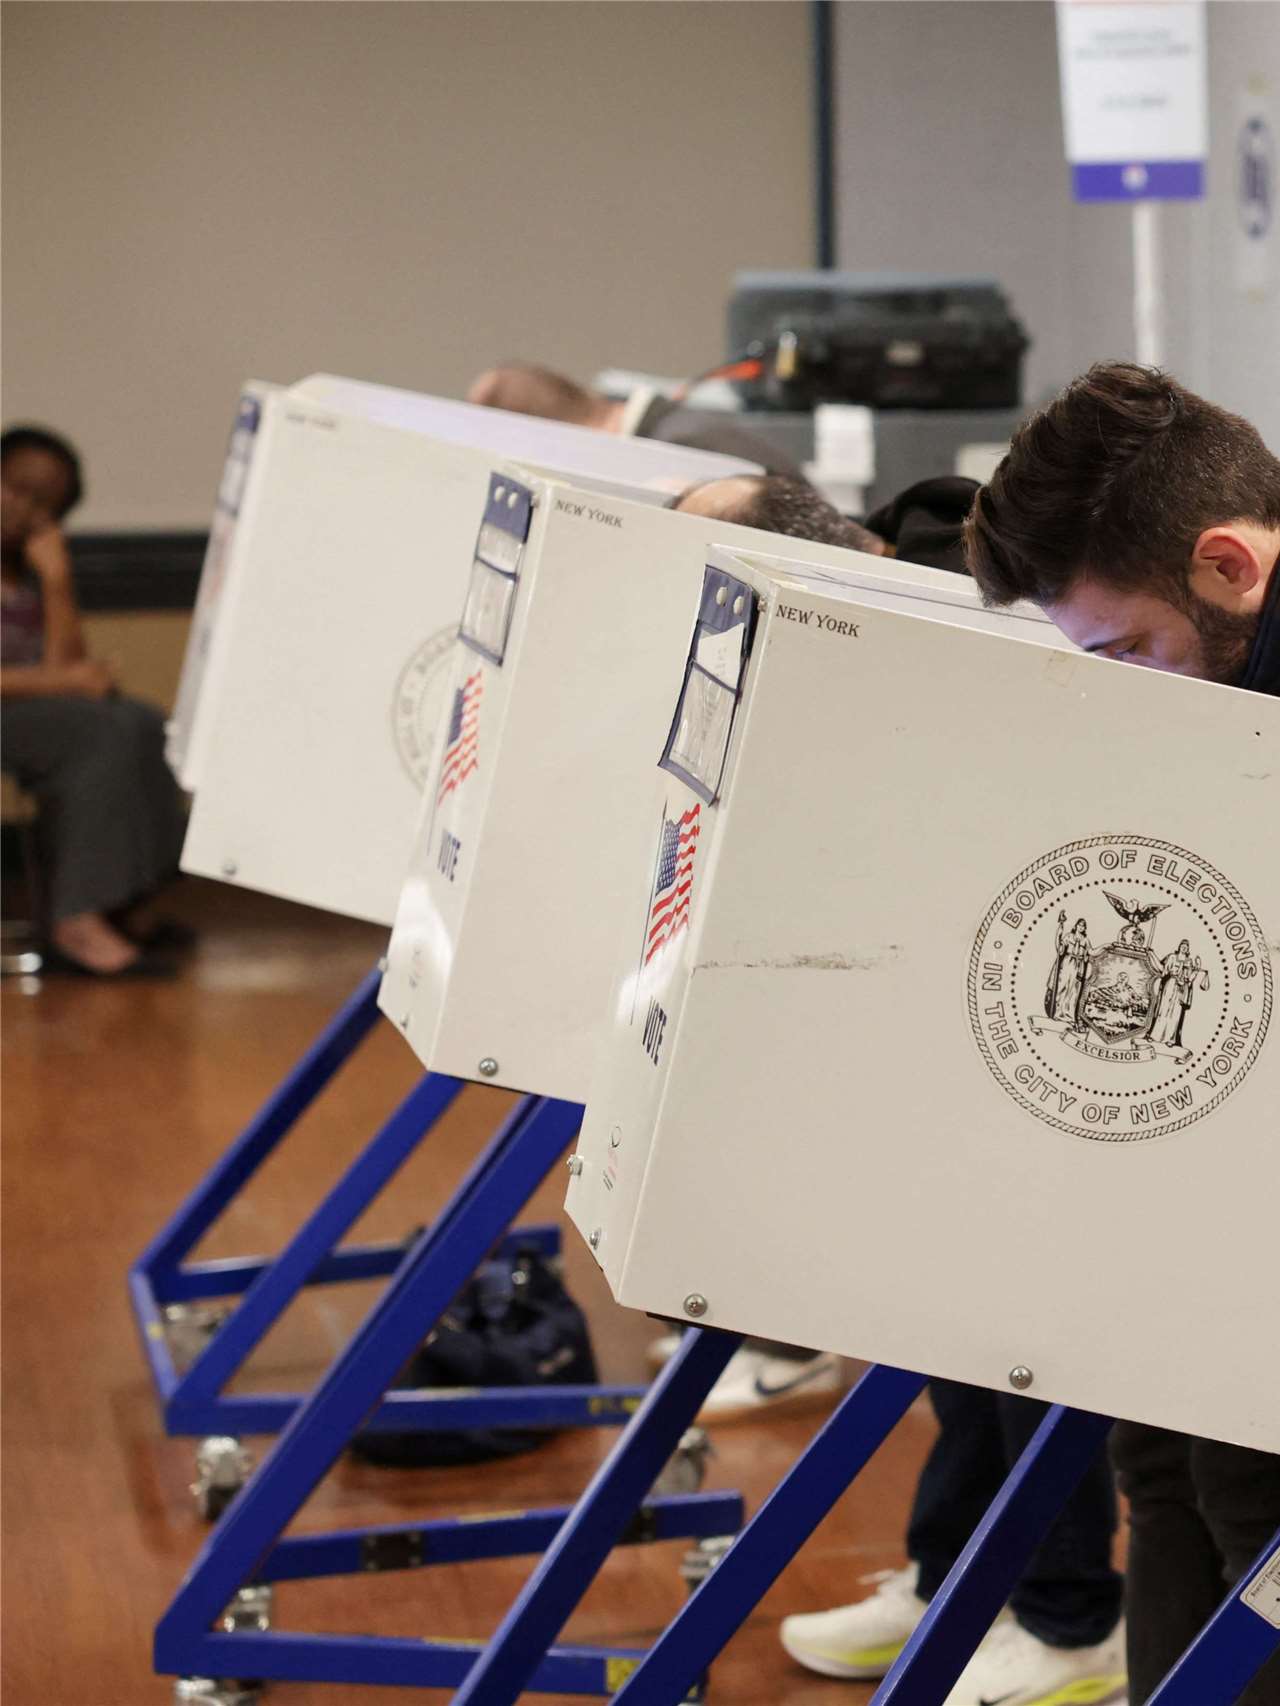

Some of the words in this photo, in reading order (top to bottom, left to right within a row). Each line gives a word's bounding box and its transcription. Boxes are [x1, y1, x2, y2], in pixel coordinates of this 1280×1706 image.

[555, 500, 583, 517] NEW
[587, 508, 625, 528] YORK
[775, 604, 814, 624] NEW
[816, 614, 861, 638] YORK
[1001, 856, 1090, 930] BOARD
[1099, 849, 1137, 870] OF
[1147, 855, 1258, 980] ELECTIONS
[982, 962, 1003, 991] IN
[642, 995, 667, 1066] VOTE
[985, 1001, 1019, 1060] THE
[1075, 1040, 1140, 1061] EXCELSIOR
[1196, 1016, 1253, 1090] YORK
[1014, 1063, 1077, 1113] CITY
[1130, 1085, 1194, 1125] NEW
[1081, 1103, 1120, 1125] OF
